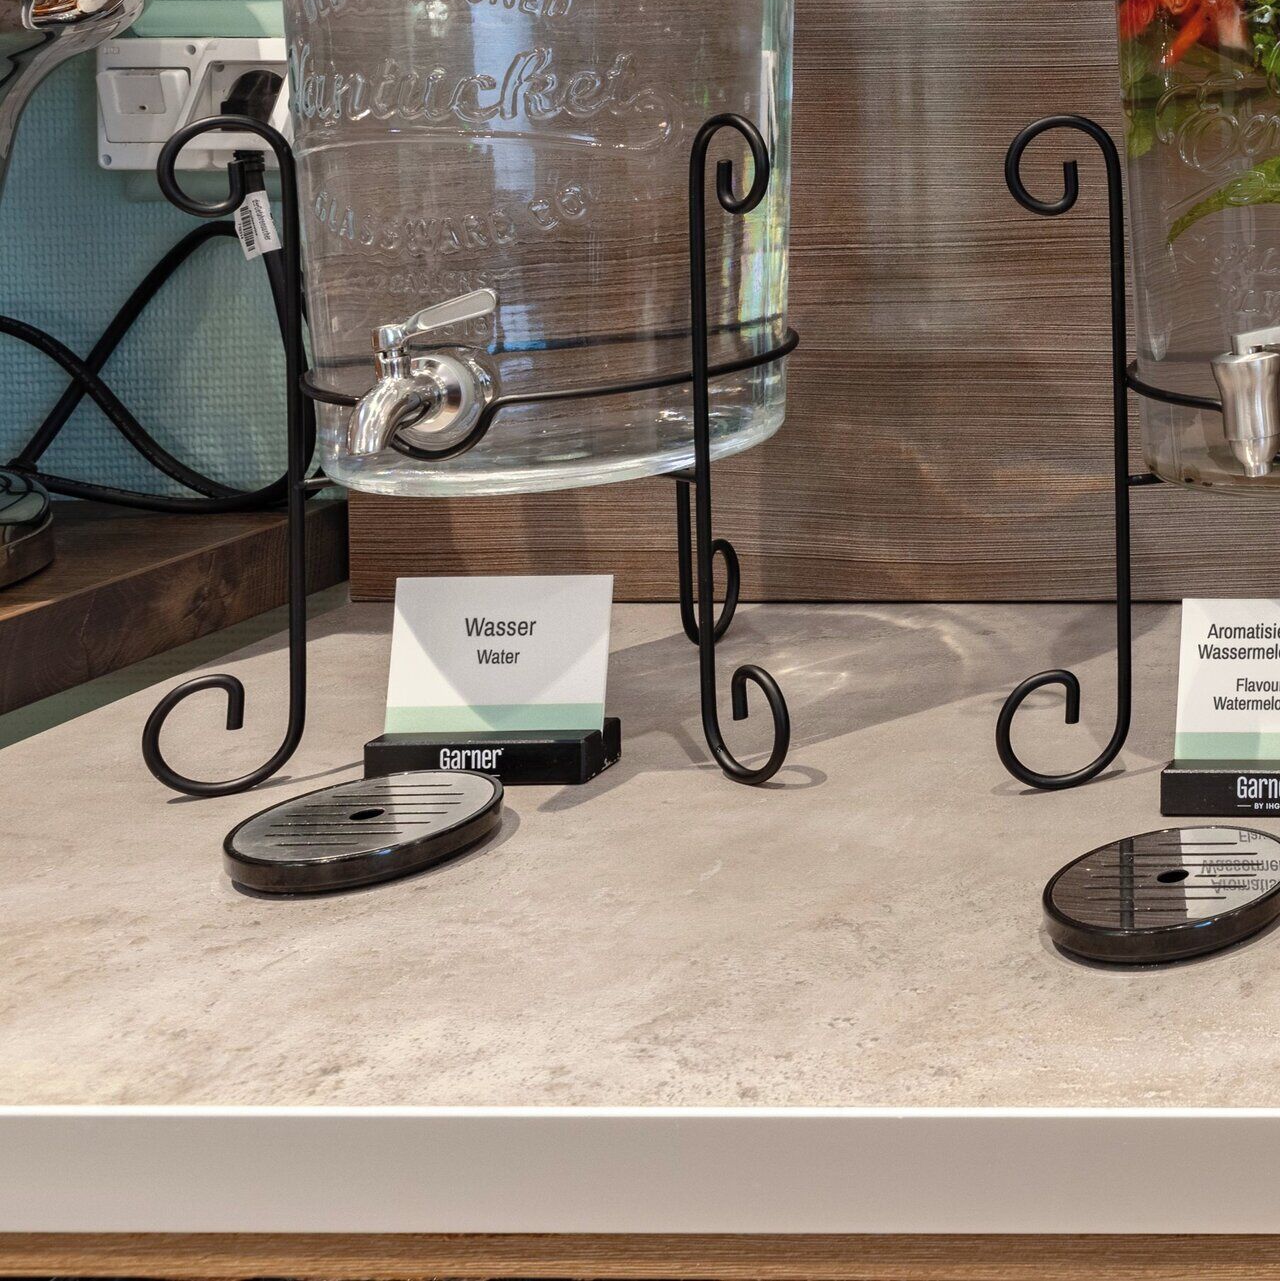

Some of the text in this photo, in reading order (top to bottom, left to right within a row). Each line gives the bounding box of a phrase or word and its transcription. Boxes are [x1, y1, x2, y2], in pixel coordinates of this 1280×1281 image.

[288, 44, 634, 123] Nantucket
[464, 617, 537, 637] Wasser
[477, 649, 520, 665] Water
[439, 748, 503, 770] Garner
[1253, 801, 1280, 810] BY IHG
